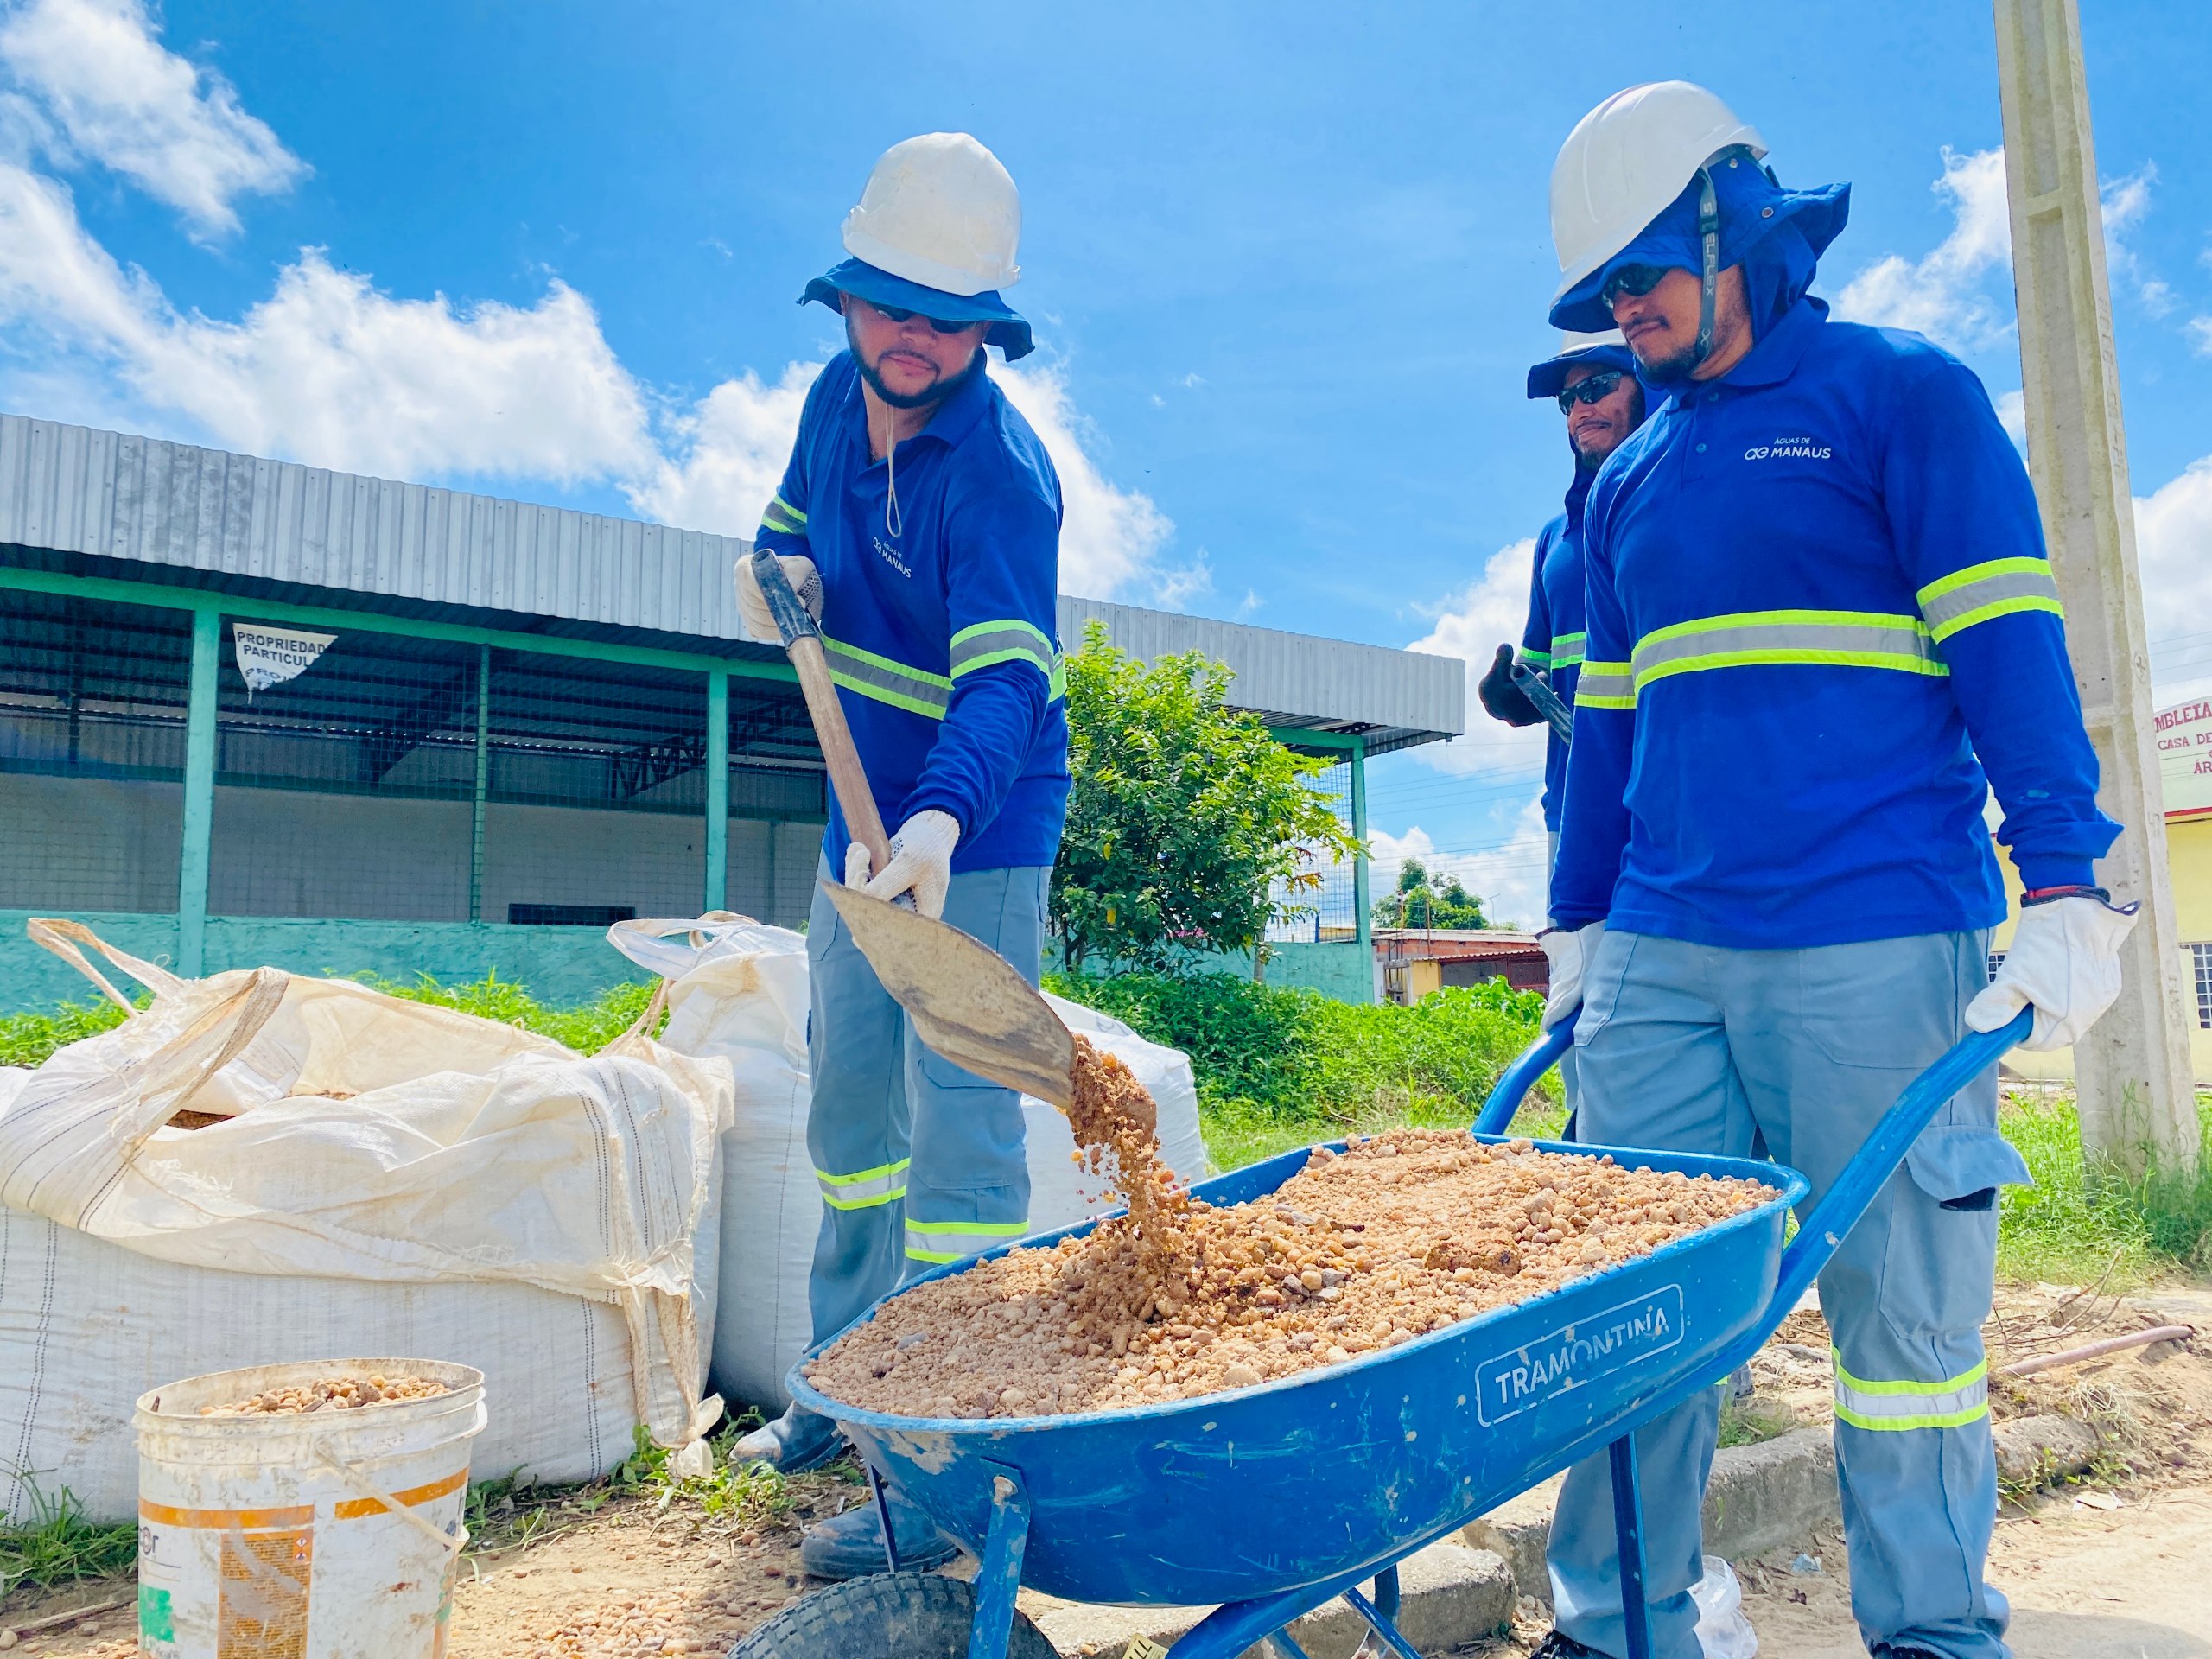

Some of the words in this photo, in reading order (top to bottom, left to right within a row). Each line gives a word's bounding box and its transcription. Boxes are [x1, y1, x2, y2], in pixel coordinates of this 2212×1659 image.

[1703, 202, 1716, 296] SELFLEX
[1770, 446, 1832, 459] MANAUS
[882, 549, 912, 578] MANAUS
[2158, 736, 2190, 750] CASA
[2196, 732, 2212, 745] DE
[1495, 1307, 1669, 1404] TRAMONTINA
